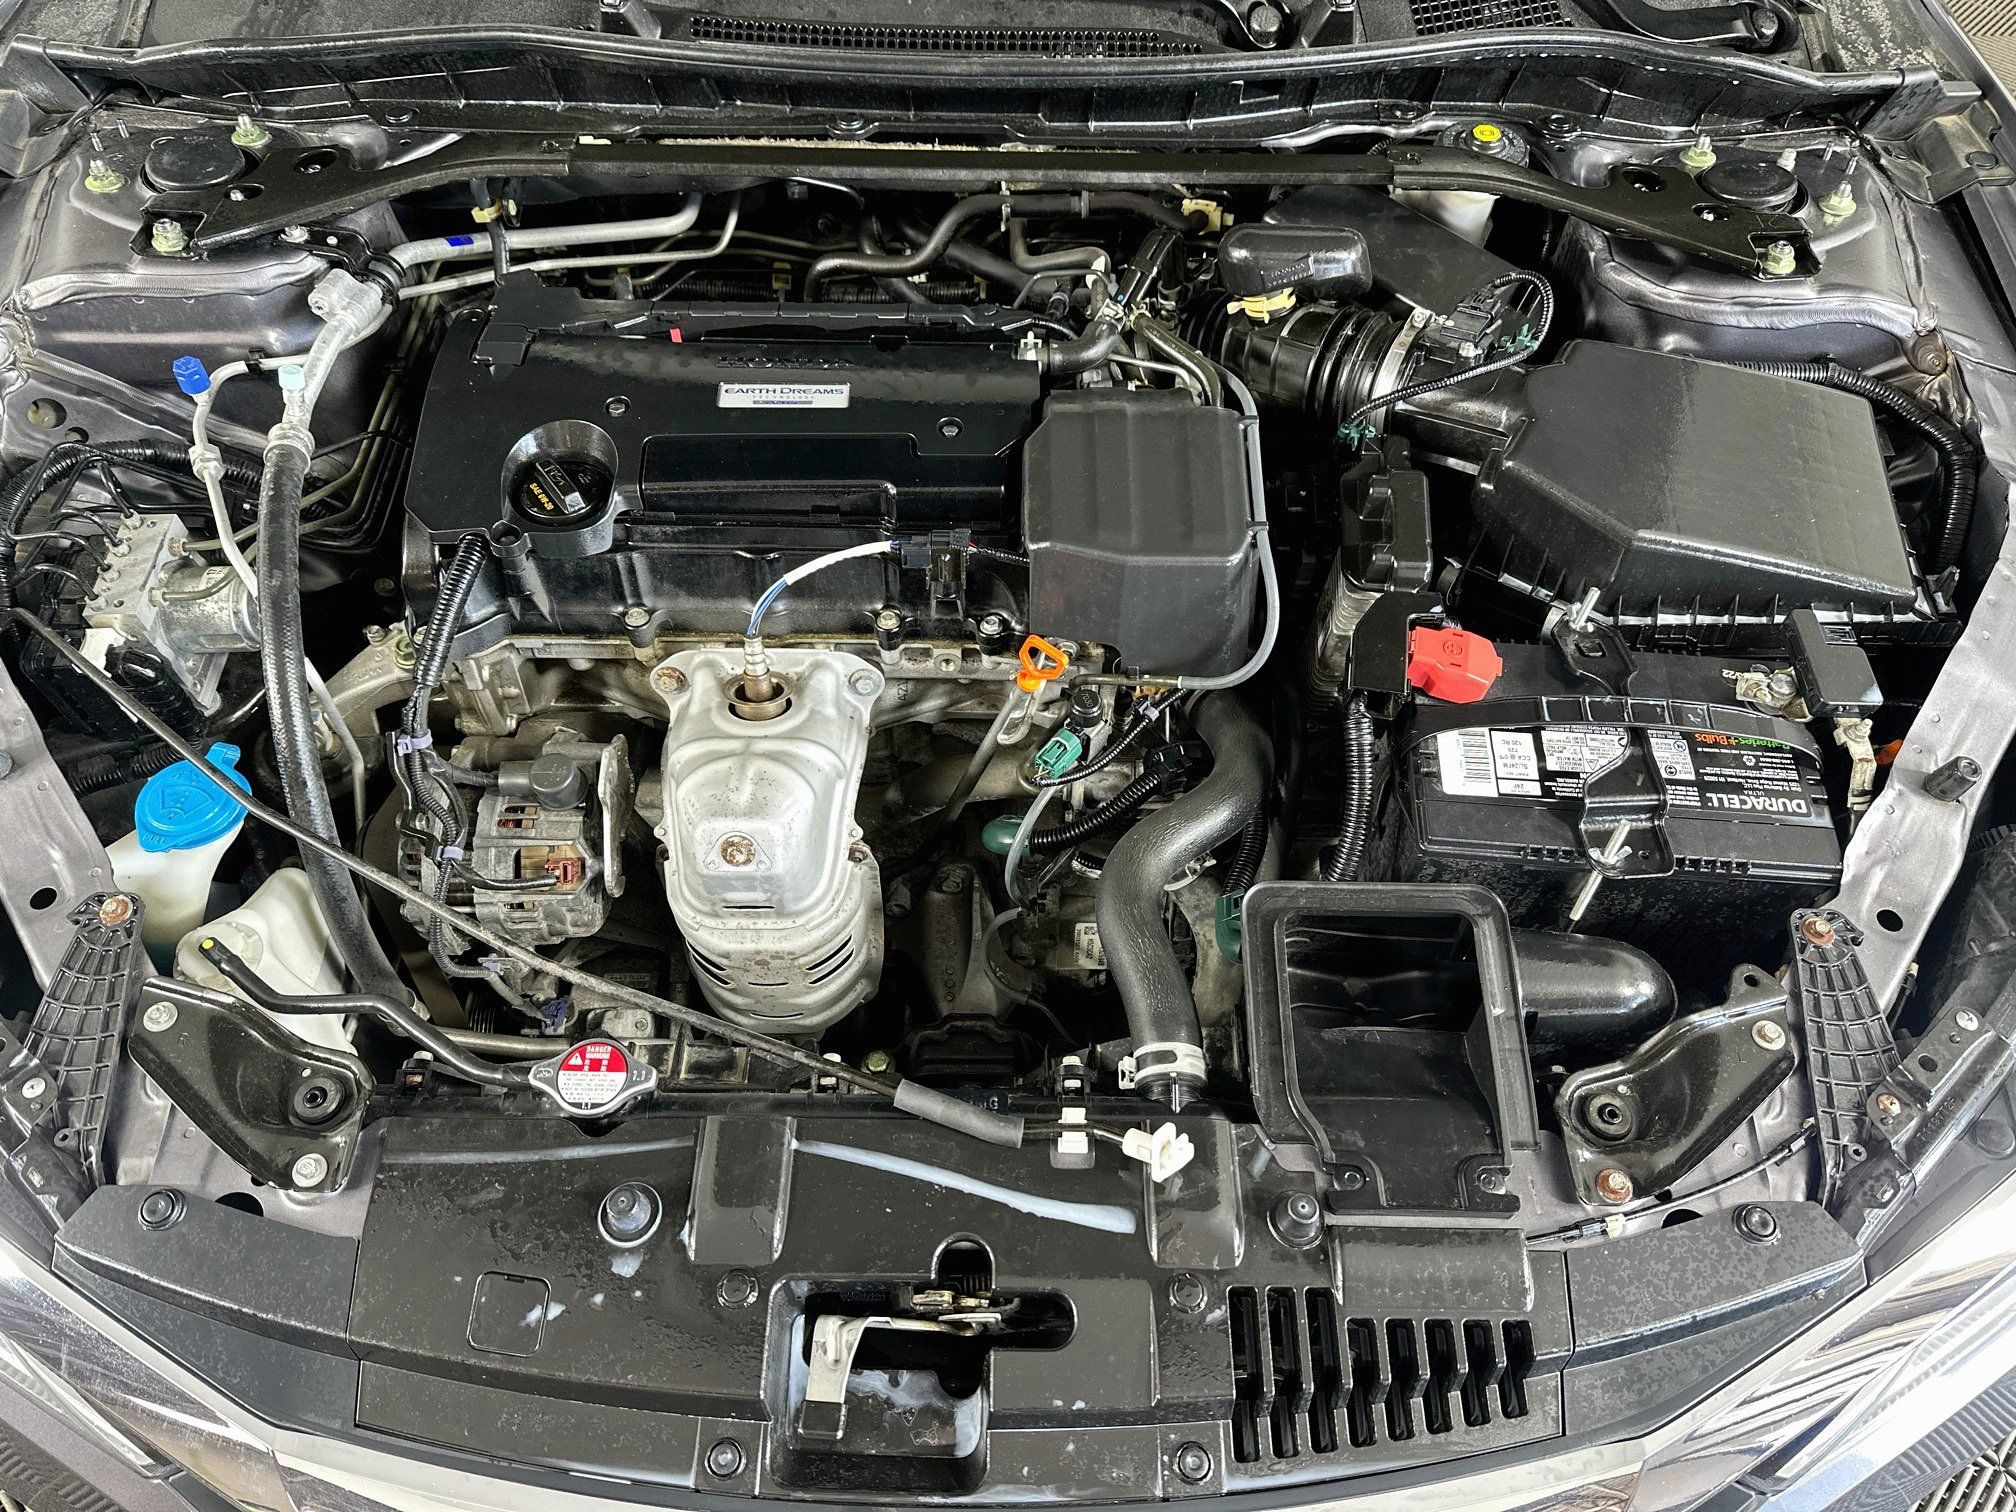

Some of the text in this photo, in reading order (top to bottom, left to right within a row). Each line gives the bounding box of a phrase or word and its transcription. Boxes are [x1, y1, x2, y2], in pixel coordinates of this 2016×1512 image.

[780, 387, 844, 395] DREAMS
[529, 482, 543, 495] SAE
[1706, 793, 1807, 814] DURACELL
[586, 1045, 612, 1053] DANGER
